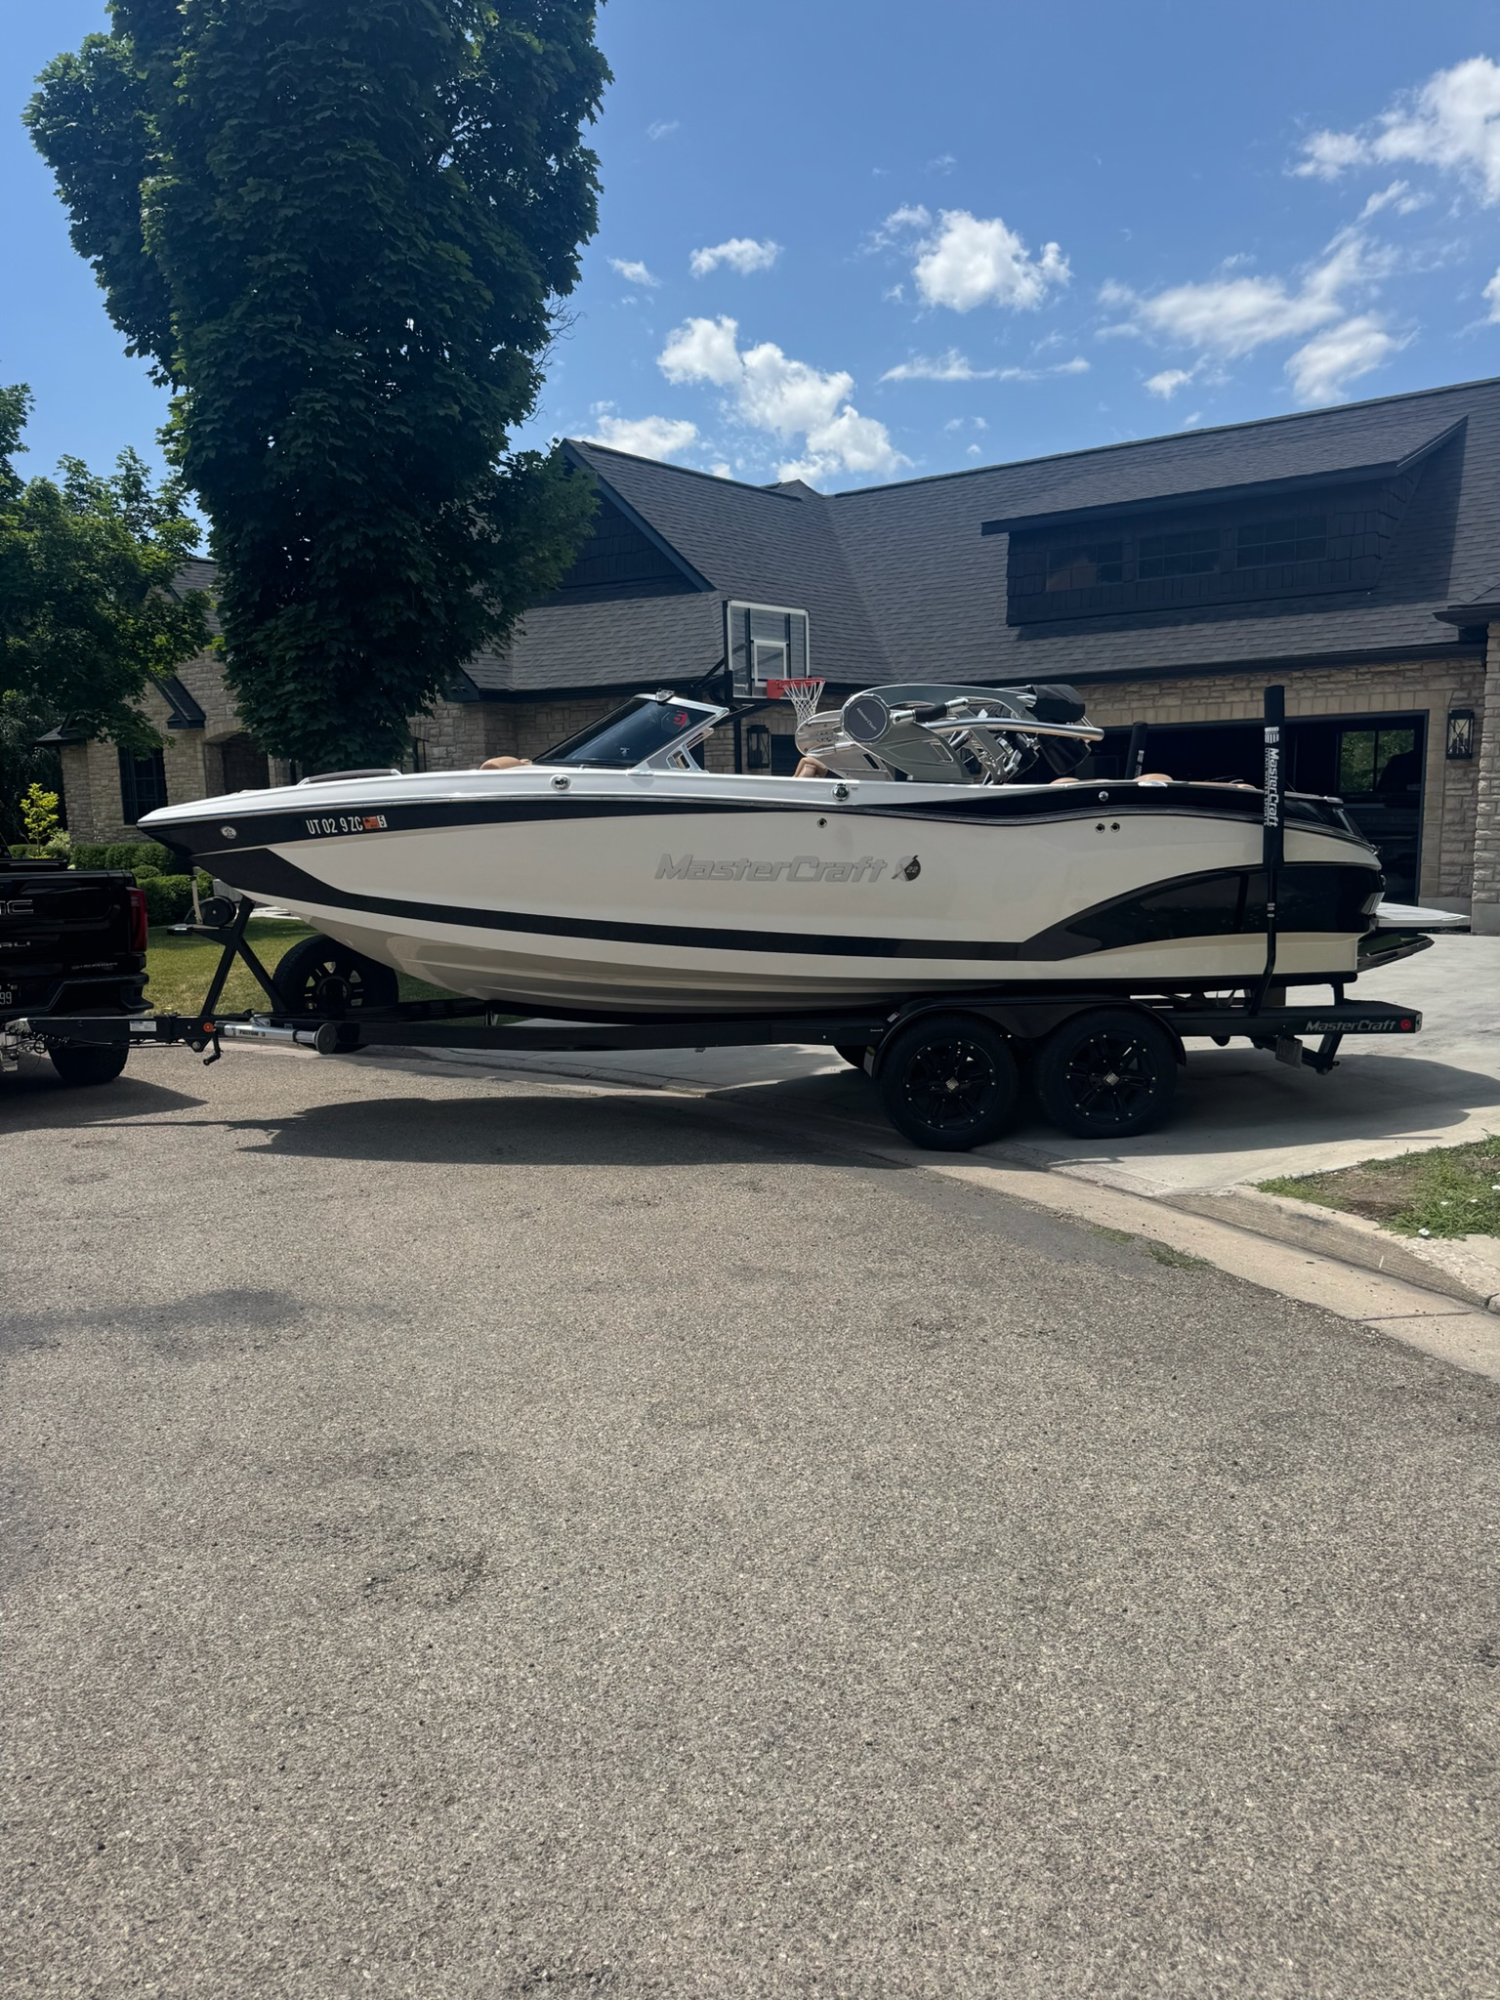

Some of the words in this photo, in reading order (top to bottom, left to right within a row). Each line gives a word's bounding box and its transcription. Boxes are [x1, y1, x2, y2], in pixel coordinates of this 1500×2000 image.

[1269, 748, 1279, 827] MasterCraft
[306, 819, 321, 834] UT
[347, 816, 363, 831] ZC
[654, 853, 888, 882] MasterCraft
[906, 865, 919, 873] 22
[1305, 1019, 1396, 1031] MasterCraft
